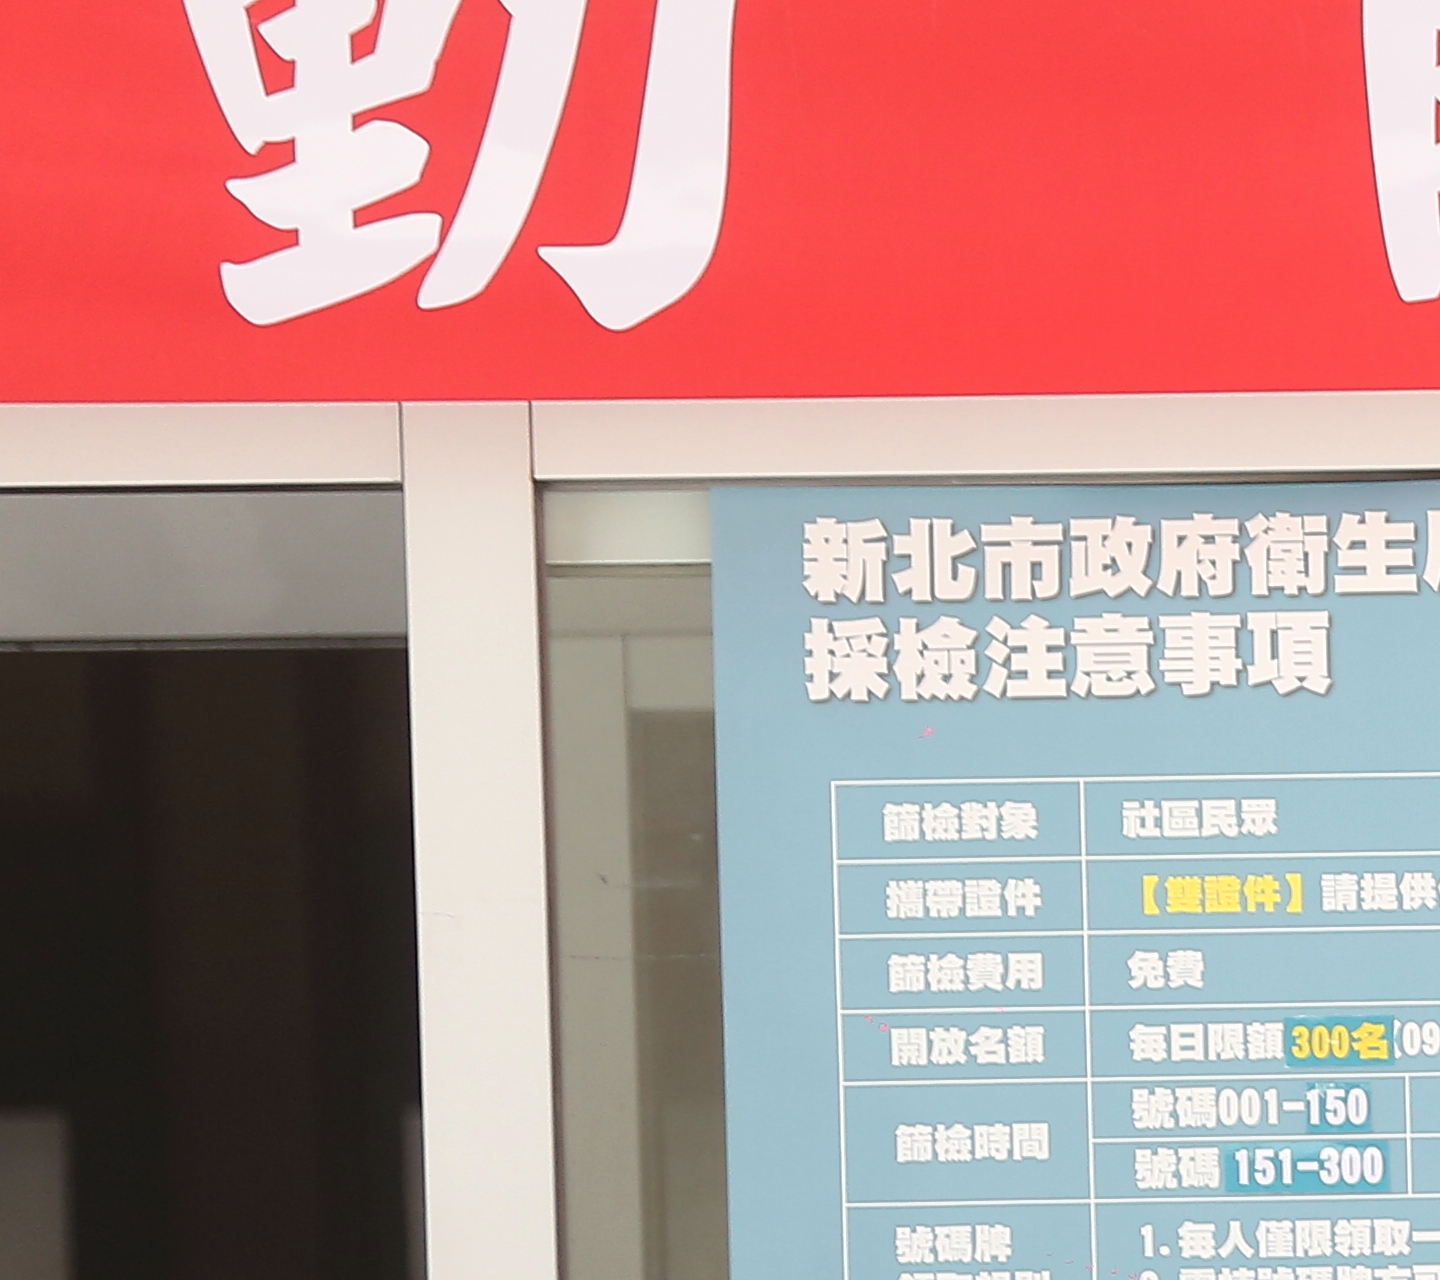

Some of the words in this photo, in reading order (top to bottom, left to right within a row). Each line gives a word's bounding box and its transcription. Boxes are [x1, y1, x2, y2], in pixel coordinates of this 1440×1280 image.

[804, 609, 1332, 701] 採檢注意事項
[882, 801, 1038, 841] 篩檢對象
[1122, 799, 1278, 838] 社區民眾
[886, 878, 1042, 919] 攜帶證件
[887, 951, 1044, 993] 篩檢費用
[1127, 949, 1205, 989] 免費
[890, 1025, 1046, 1066] 開放名額
[895, 1122, 1049, 1163] 篩檢時間
[895, 1224, 1011, 1265] 號碼牌
